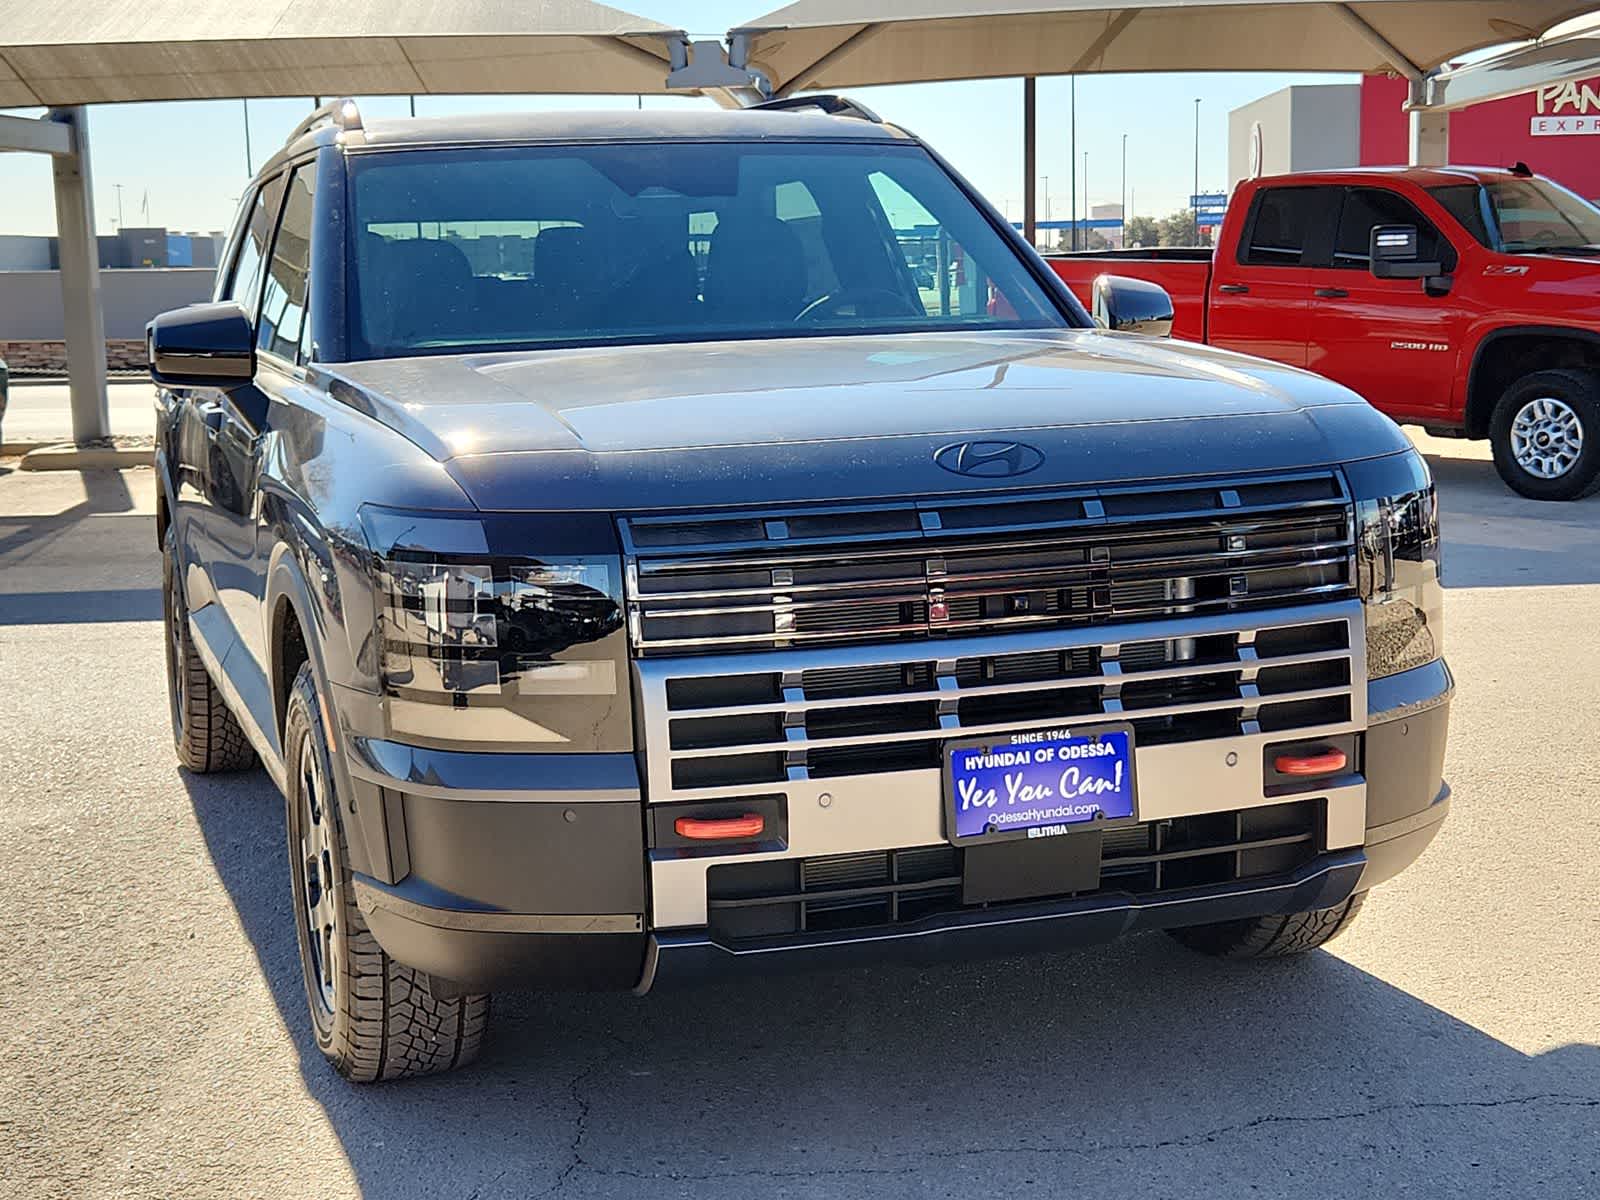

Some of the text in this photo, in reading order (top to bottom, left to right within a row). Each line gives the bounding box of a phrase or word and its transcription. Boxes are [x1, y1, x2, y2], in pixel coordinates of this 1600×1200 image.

[1391, 342, 1449, 351] 2500 HD
[1010, 729, 1071, 745] SINCE 1946
[965, 742, 1115, 771] HYUNDAI OF ODESSA
[957, 760, 1123, 810] Yes You Can!
[988, 803, 1100, 825] OdessaHyundai.com
[1038, 825, 1068, 837] LITHIA
